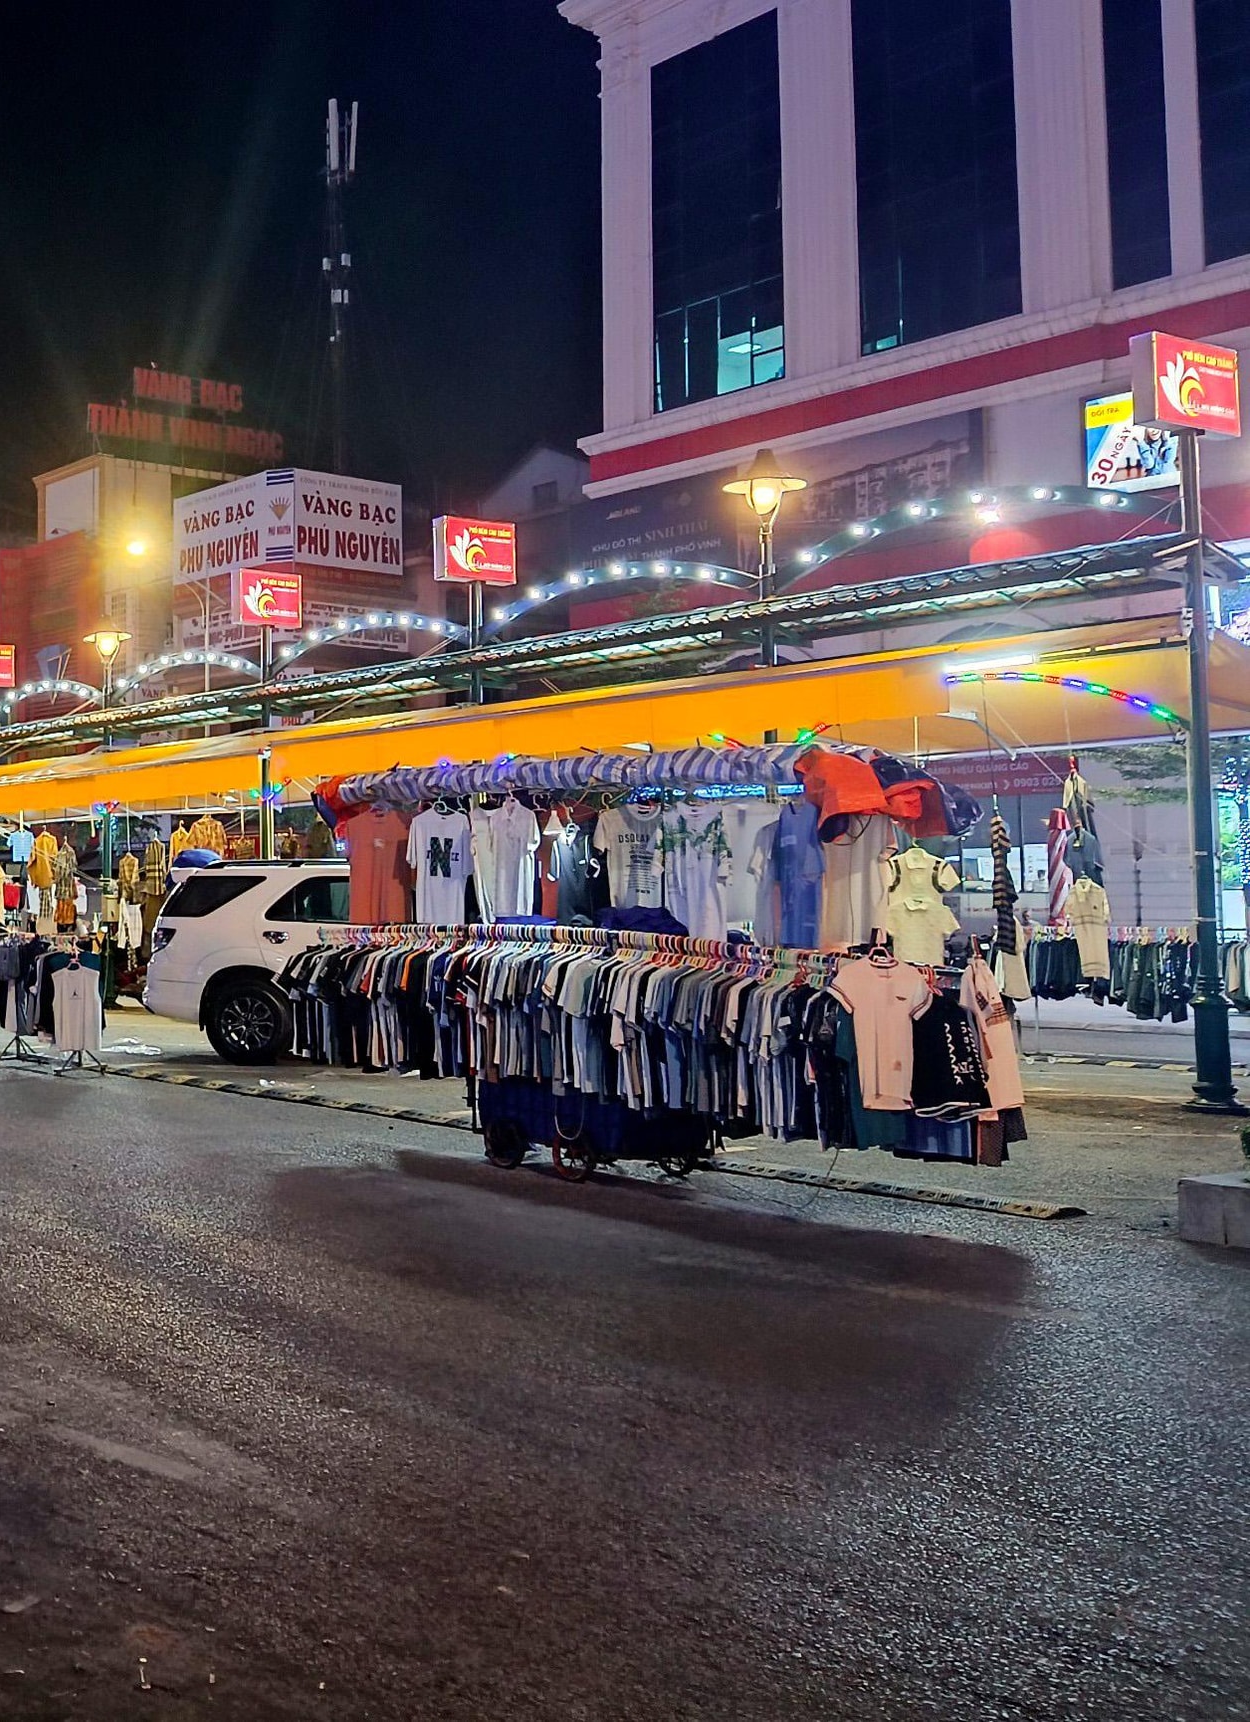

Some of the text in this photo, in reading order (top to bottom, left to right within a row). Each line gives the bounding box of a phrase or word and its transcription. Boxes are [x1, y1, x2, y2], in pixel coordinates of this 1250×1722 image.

[1092, 458, 1114, 485] 30
[184, 500, 255, 534] VÀNG BẠC
[302, 490, 396, 526] VÀNG BẠC
[207, 528, 259, 568] NGUYÊN
[297, 524, 400, 566] PHÚ NGUYÊN
[697, 538, 722, 550] VINH
[1010, 760, 1029, 770] CÁO
[1013, 777, 1040, 788] 0903
[430, 836, 453, 878] N
